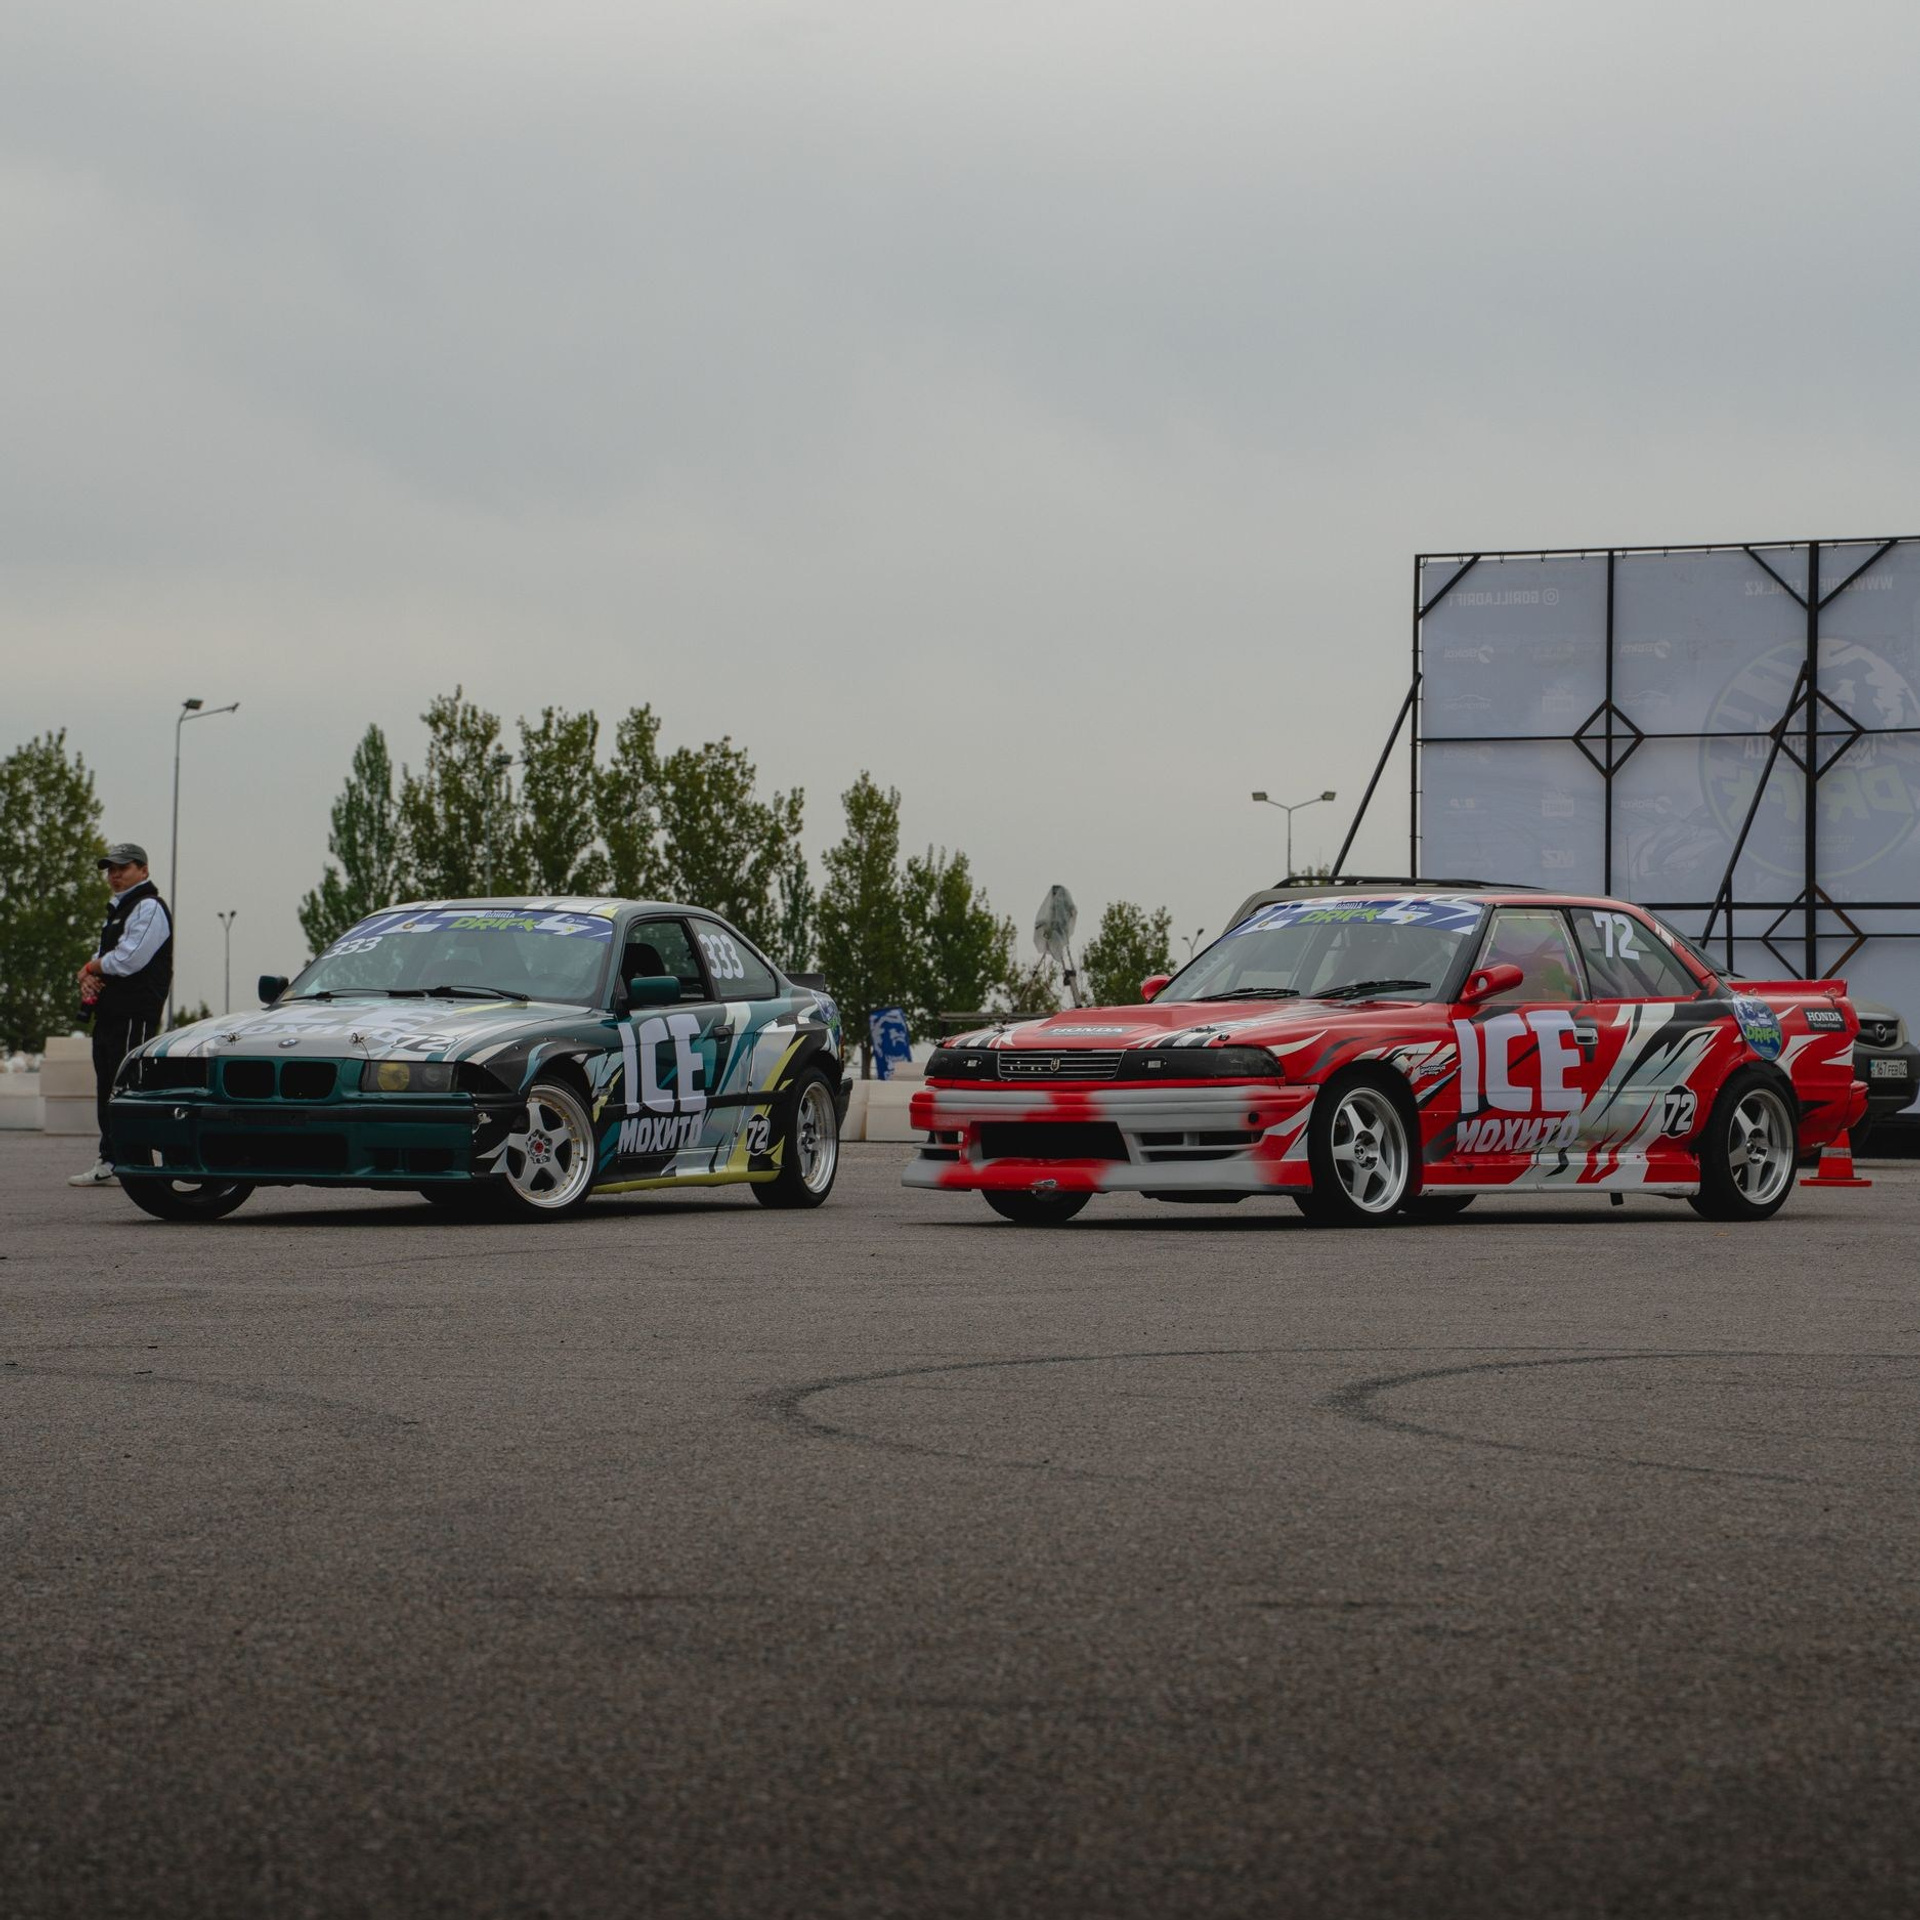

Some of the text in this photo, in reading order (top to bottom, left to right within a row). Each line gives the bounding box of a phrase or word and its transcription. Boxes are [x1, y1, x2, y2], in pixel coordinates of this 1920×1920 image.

[321, 936, 384, 960] 333
[1593, 911, 1640, 960] 72
[698, 933, 745, 979] 333
[1806, 1011, 1844, 1022] HONDA
[395, 1034, 454, 1051] 72
[618, 1013, 707, 1115] ICE
[1453, 1010, 1586, 1114] ICE
[1661, 1095, 1696, 1132] 72
[617, 1115, 704, 1153] МОХИТО
[746, 1120, 769, 1150] 72
[1456, 1115, 1580, 1153] МОХИТО
